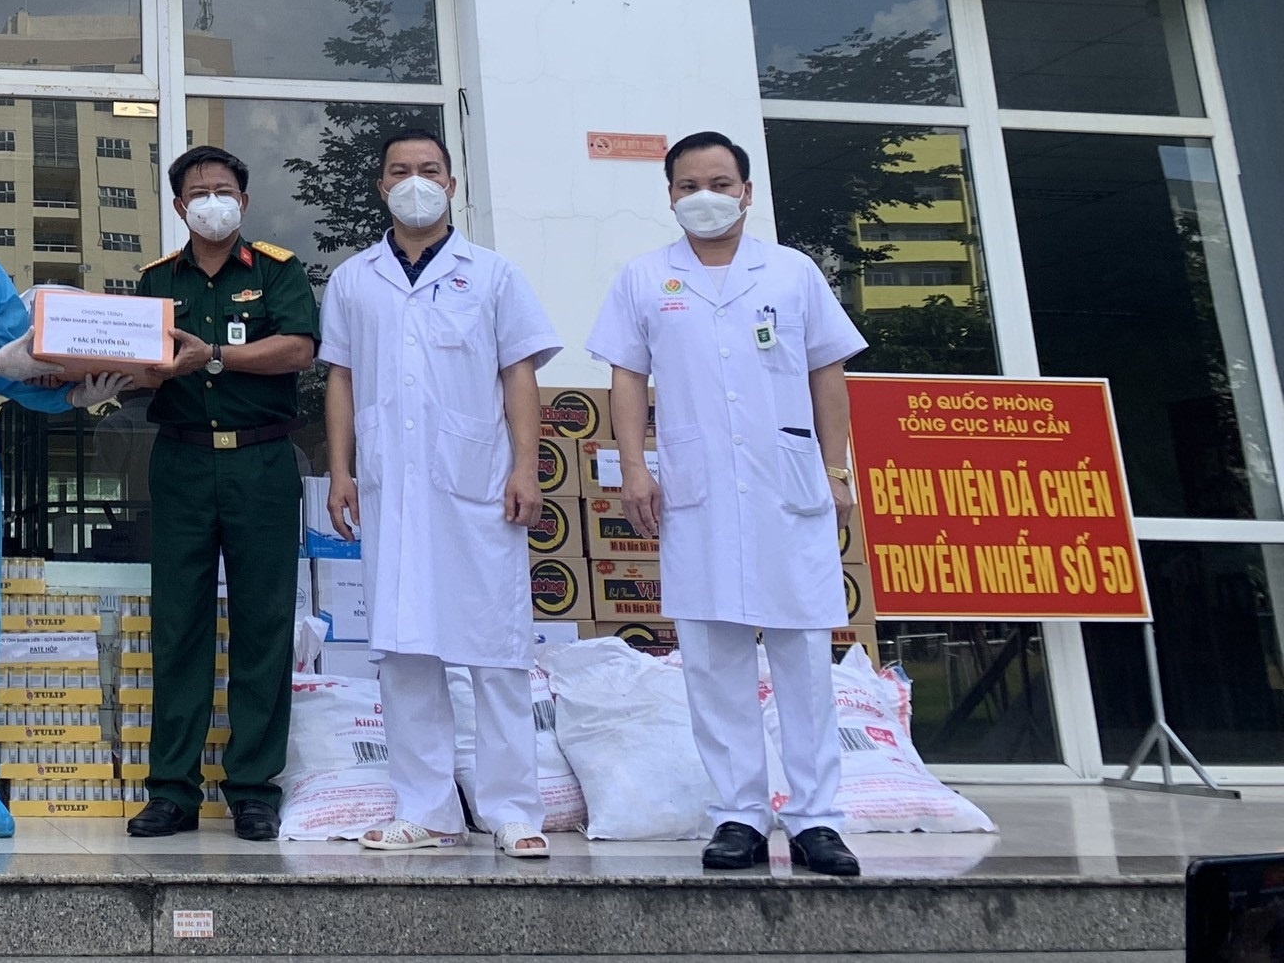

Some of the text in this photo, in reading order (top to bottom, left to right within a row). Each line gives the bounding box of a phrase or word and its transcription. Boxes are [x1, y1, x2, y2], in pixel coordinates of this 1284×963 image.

[898, 410, 1071, 436] TỔNG CỤC HẬU CẦN
[907, 391, 1054, 413] BỘ QUỐC PHÒNG
[869, 456, 1116, 526] BỆNH VIỆN DÃ CHIẾN
[874, 529, 1135, 595] TRUYỀN NHIỄM SỐ 5D
